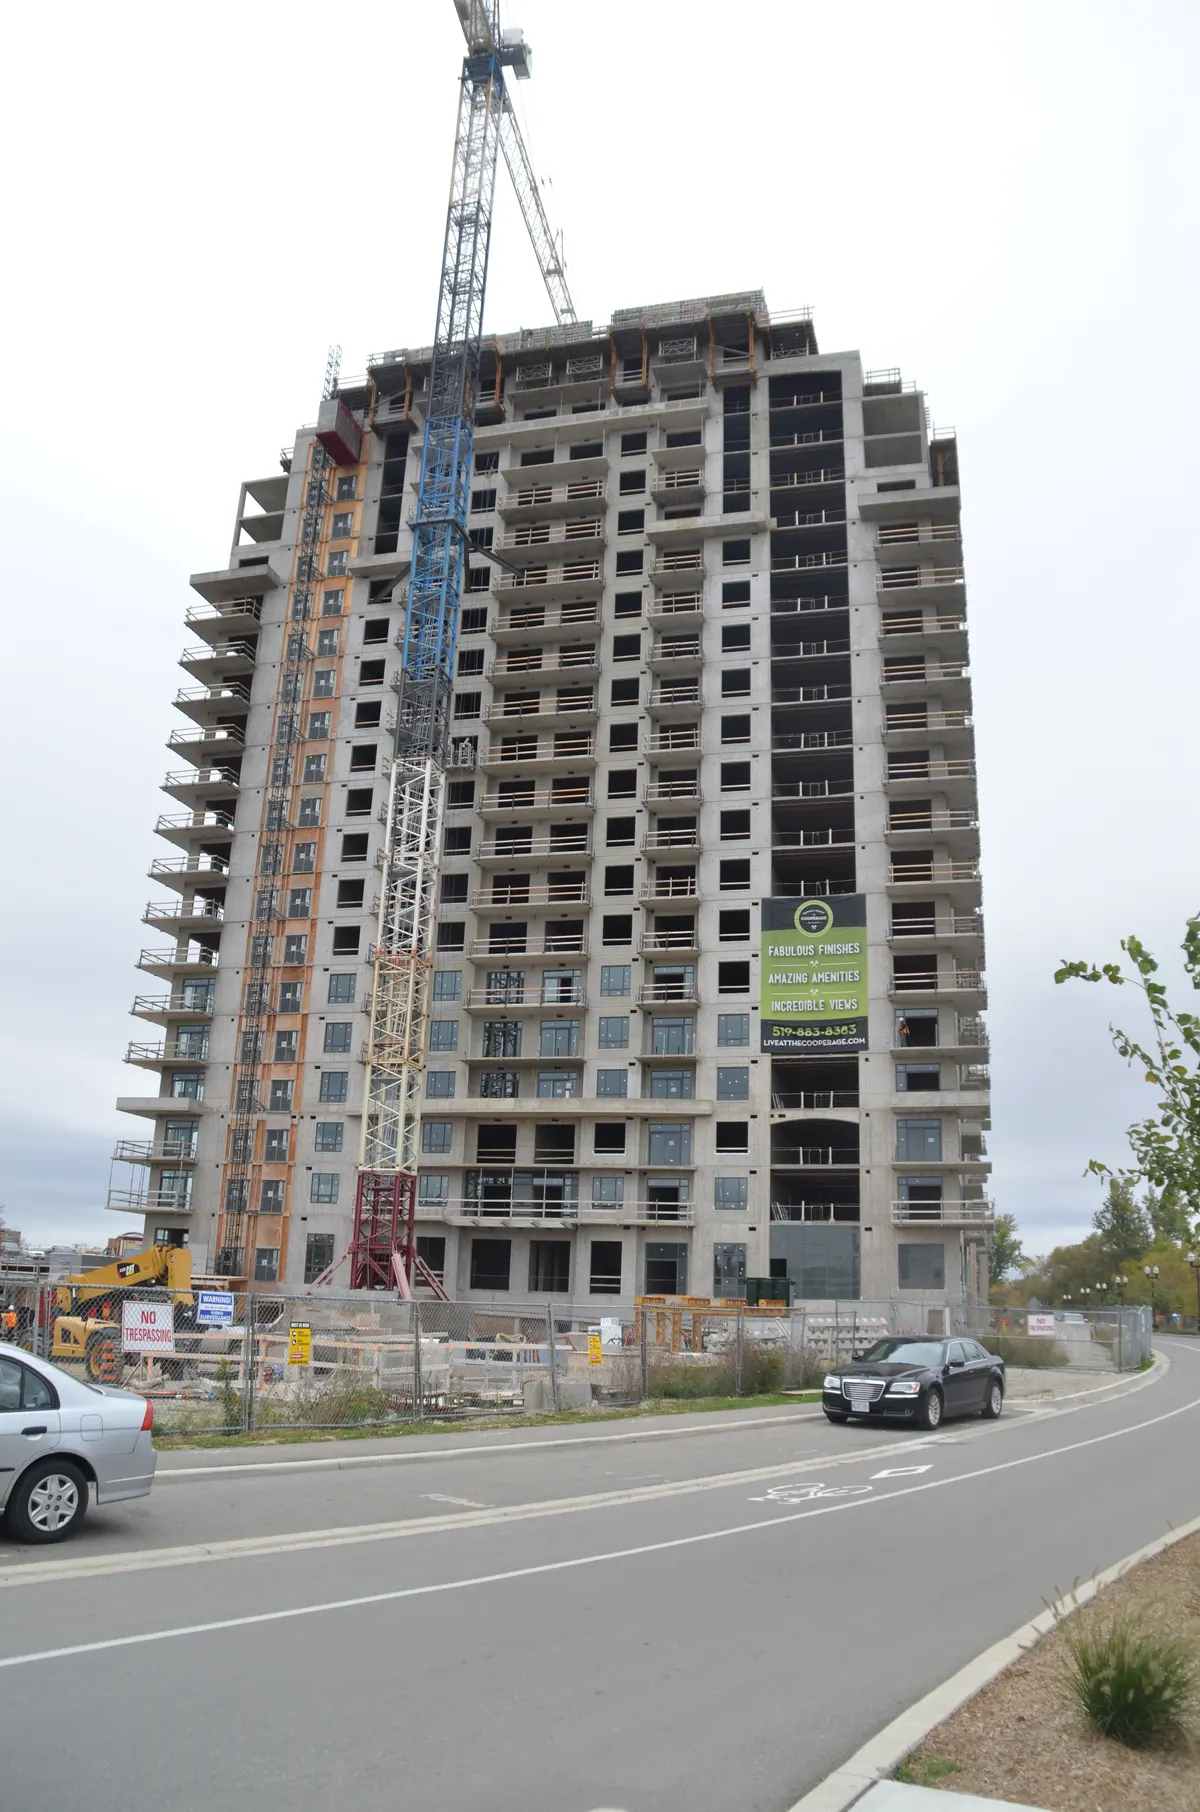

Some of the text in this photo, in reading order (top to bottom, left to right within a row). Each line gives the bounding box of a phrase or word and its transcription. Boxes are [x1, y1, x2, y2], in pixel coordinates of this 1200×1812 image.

[768, 942, 860, 957] FABULOUS FINISHES
[768, 970, 860, 984] AMAZING AMENITIES
[771, 998, 858, 1012] INCREDIBLE VIEWS
[772, 1024, 857, 1037] 519-883-8383
[763, 1037, 866, 1047] LIVEATTHECOOPERAGE.COM
[202, 1295, 232, 1304] WARNING!
[141, 1310, 157, 1325] NO
[125, 1327, 172, 1342] TRESPASSING
